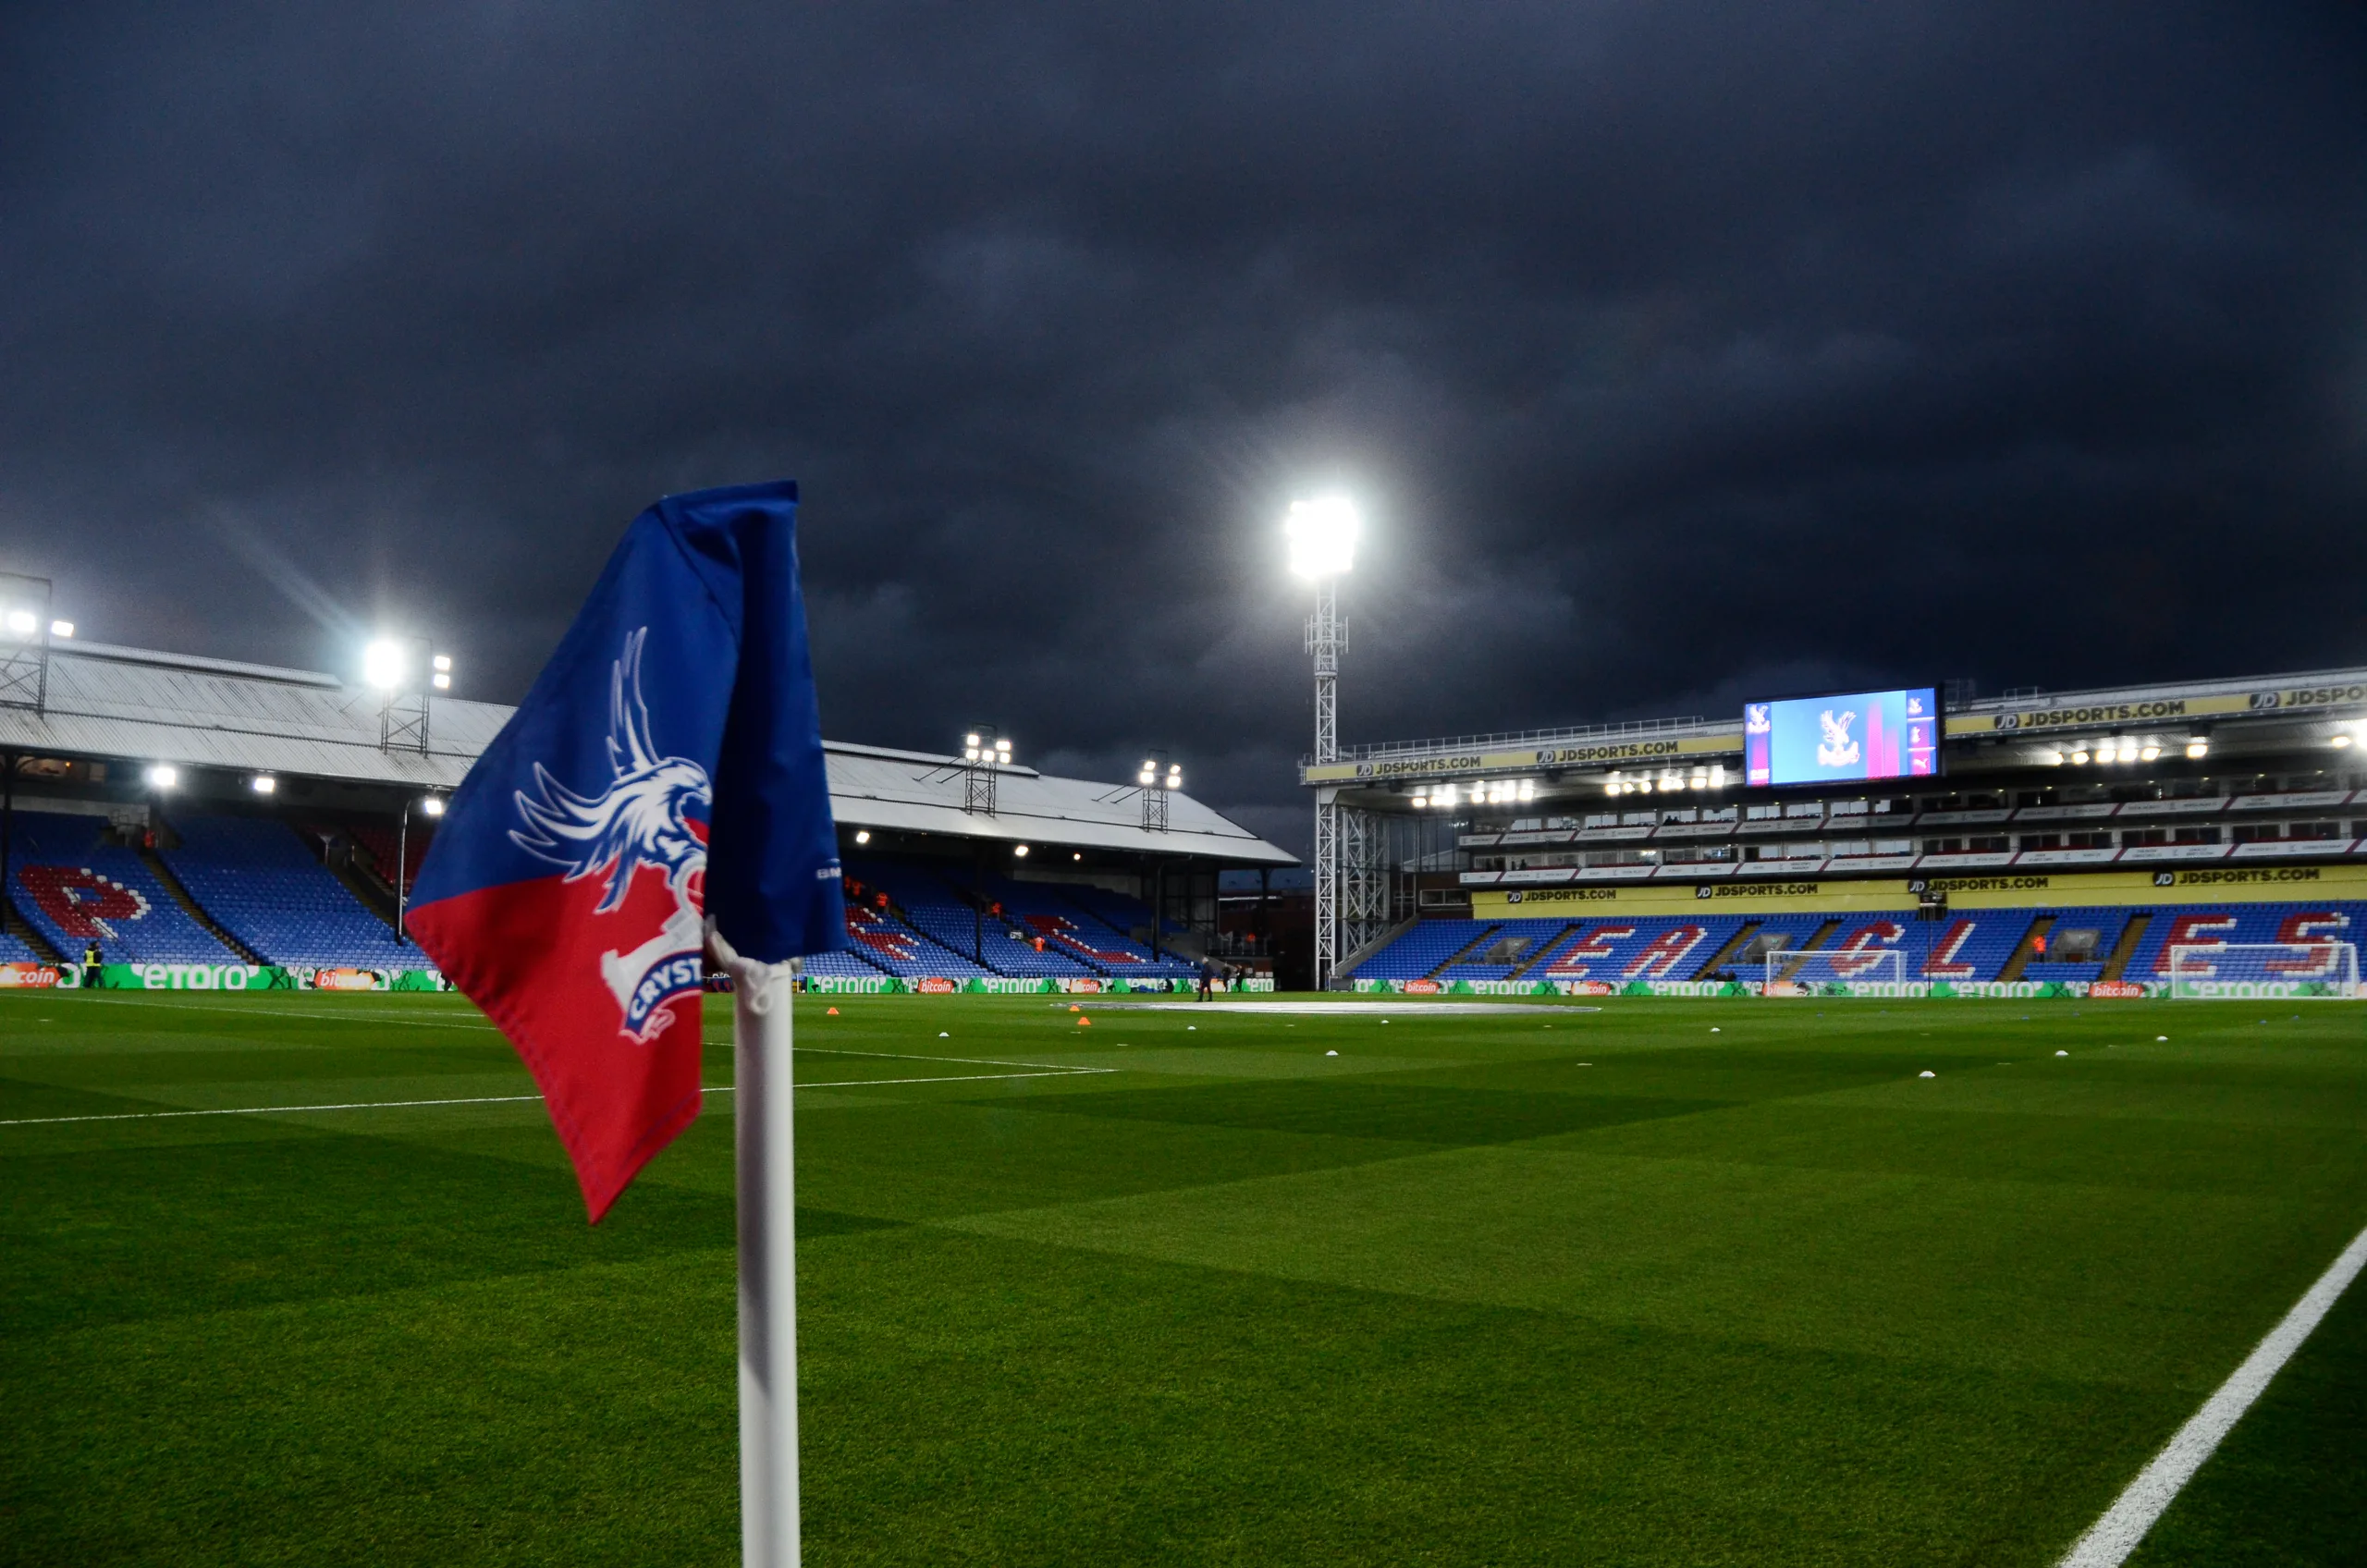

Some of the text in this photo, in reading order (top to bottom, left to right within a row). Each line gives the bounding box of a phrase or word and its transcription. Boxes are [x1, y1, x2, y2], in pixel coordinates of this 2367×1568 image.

[2254, 686, 2367, 709] JD JDSPO
[1998, 701, 2186, 729] JD JDSPORTS.COM
[1539, 741, 1678, 763] JD JDSPORTS.COM
[1376, 757, 1481, 775] JDSPORTS.COM
[1910, 876, 2048, 892] JD JDSPORTS.COM
[2156, 868, 2320, 885] JD JDSPORTS.COM
[1525, 888, 1617, 901] JDSPORTS.COM
[1715, 884, 1819, 897] JDSPORTS.COM
[630, 957, 703, 1021] CRYST
[1406, 983, 1437, 994] bitcoin
[2093, 983, 2139, 998] bitcoin
